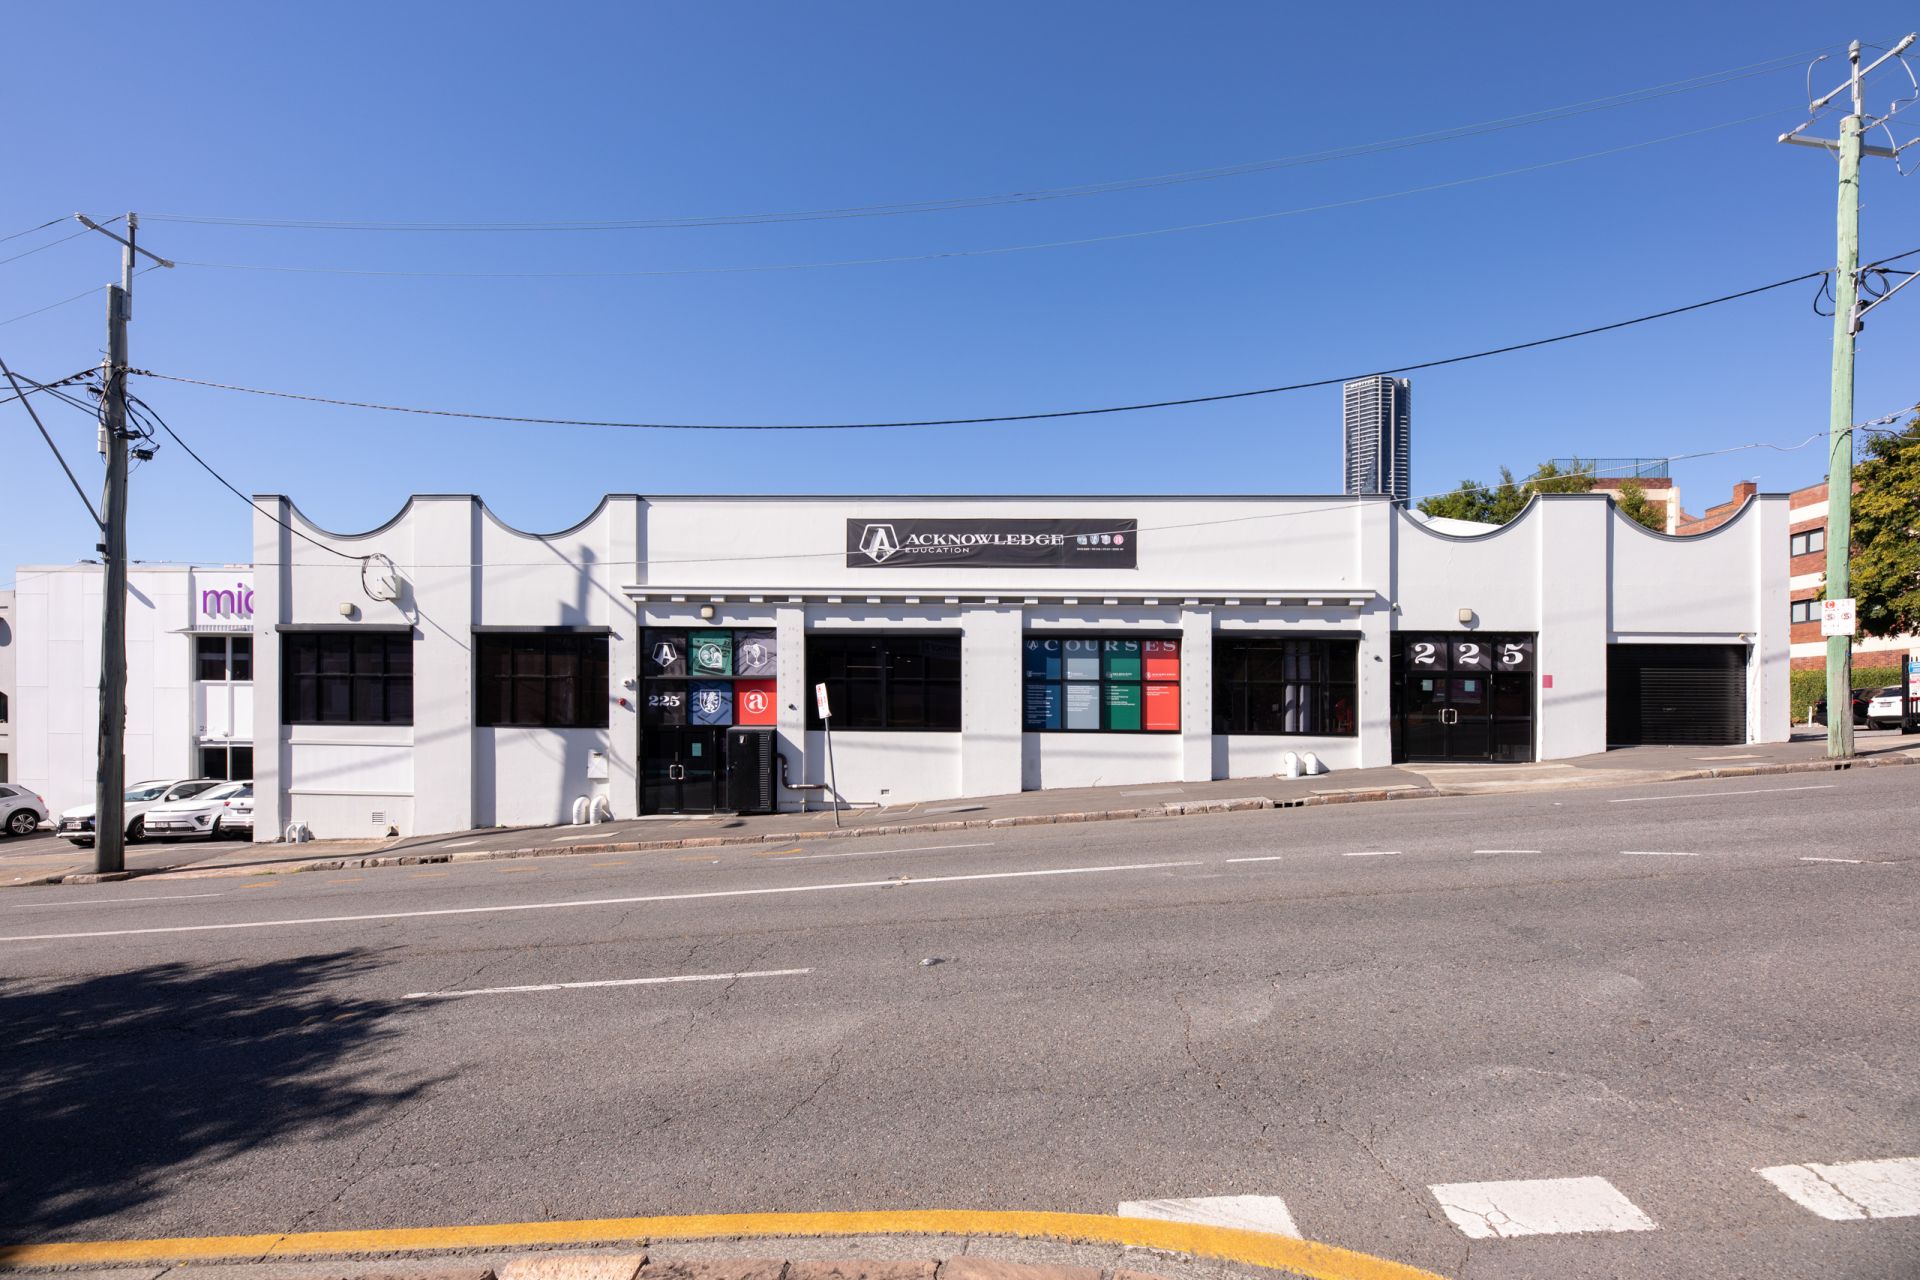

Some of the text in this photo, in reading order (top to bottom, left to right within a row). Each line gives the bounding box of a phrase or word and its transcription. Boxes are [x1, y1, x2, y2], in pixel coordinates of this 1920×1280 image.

[905, 533, 1064, 546] ACKNOWLEDGE
[1044, 640, 1176, 652] COURSES
[648, 695, 681, 707] 225
